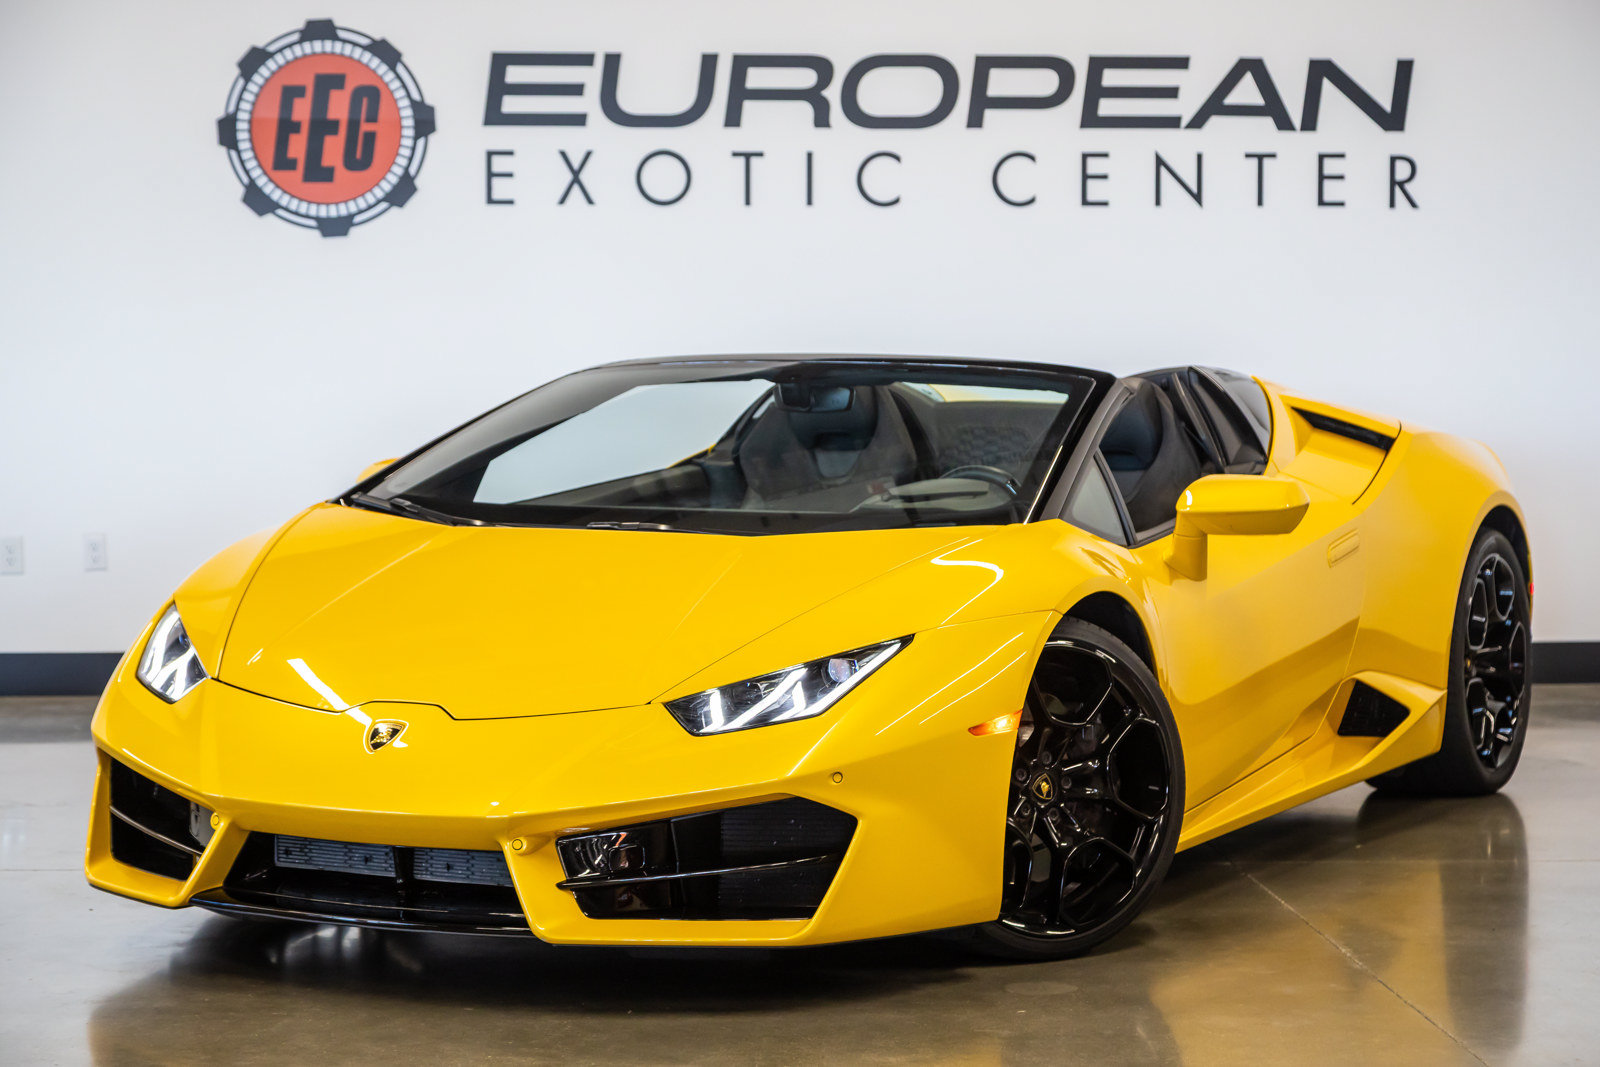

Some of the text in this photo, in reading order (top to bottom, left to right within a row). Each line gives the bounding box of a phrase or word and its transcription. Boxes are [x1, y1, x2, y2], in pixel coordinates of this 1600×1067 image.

[271, 73, 381, 183] EEC
[483, 52, 1415, 132] EUROPEAN
[486, 150, 1419, 209] EXOTIC CENTER
